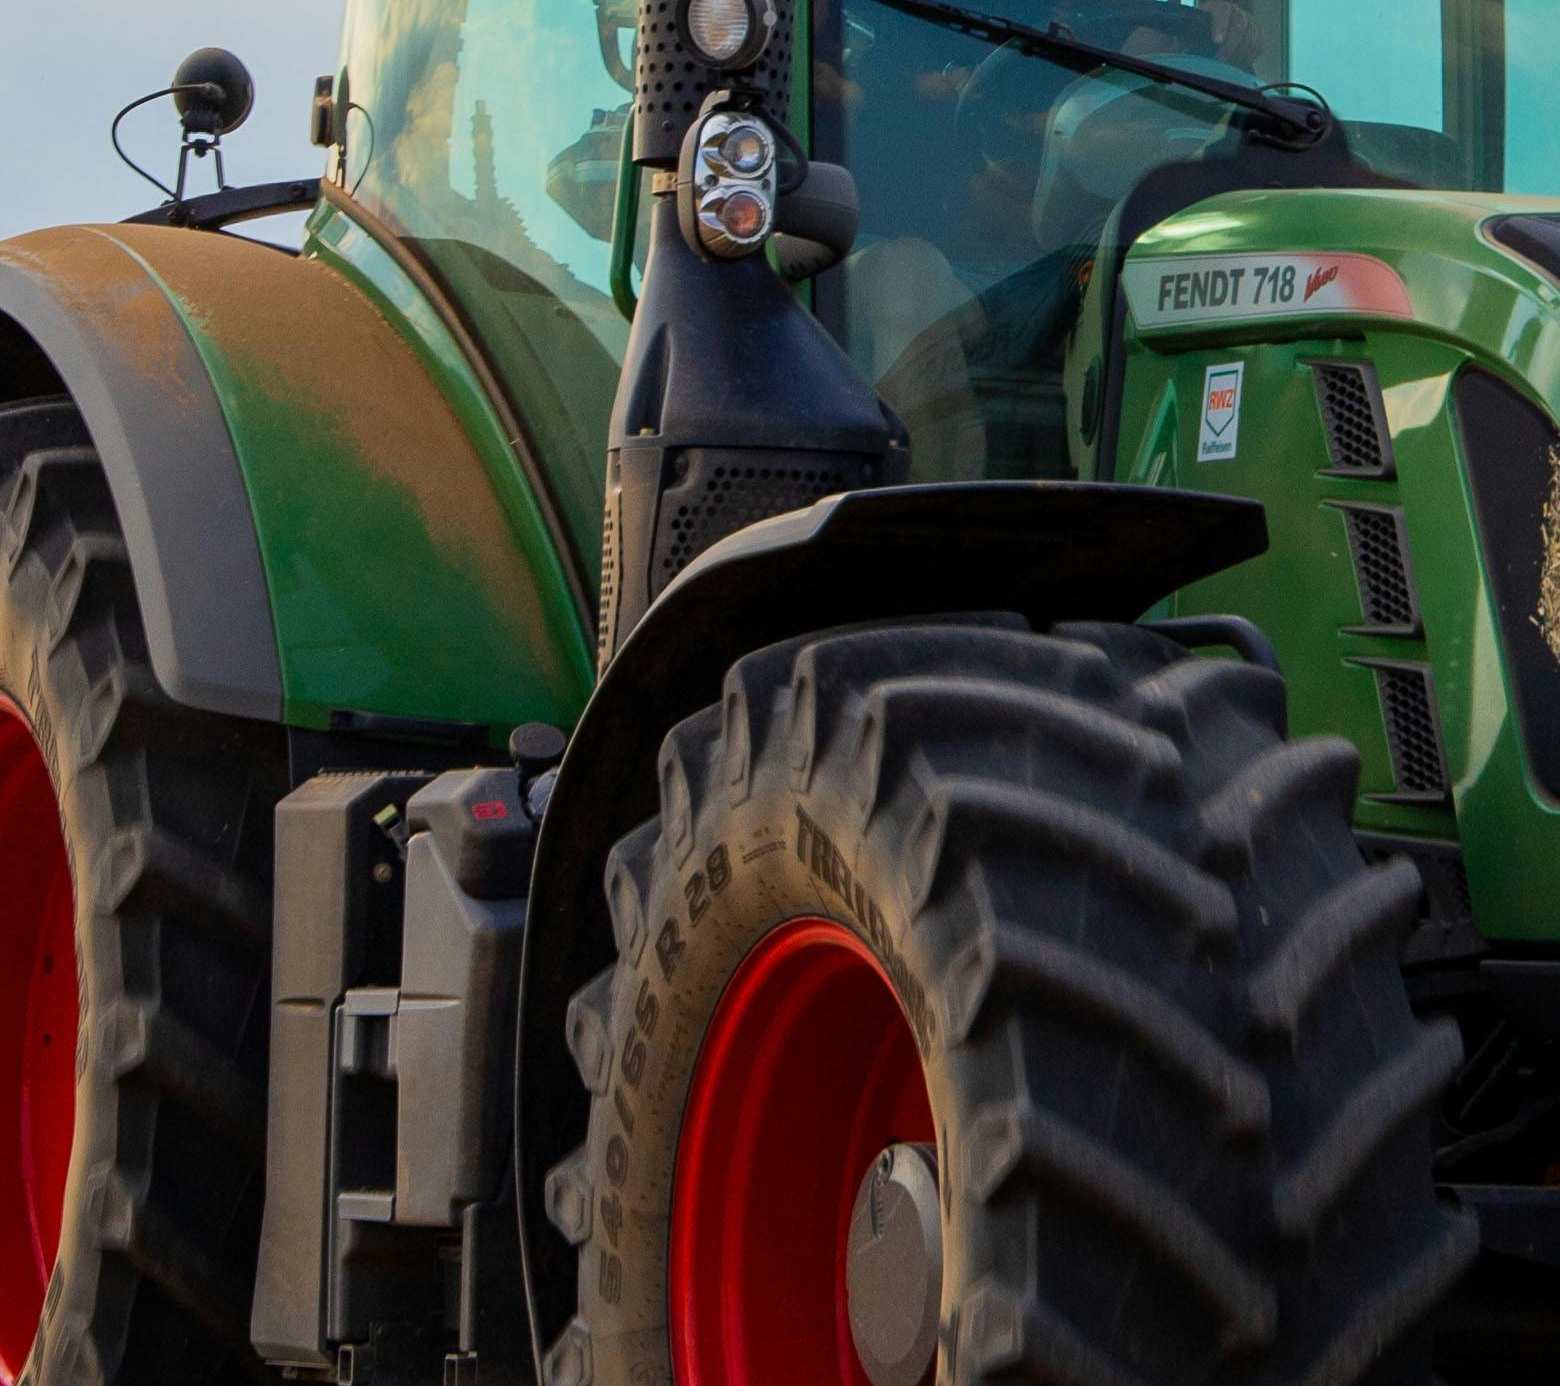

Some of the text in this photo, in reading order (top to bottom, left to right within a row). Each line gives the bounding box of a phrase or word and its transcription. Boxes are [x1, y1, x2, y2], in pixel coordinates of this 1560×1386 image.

[1158, 268, 1244, 311] FENDT
[1253, 265, 1296, 304] 718
[655, 917, 686, 981] R
[684, 842, 732, 927] 28
